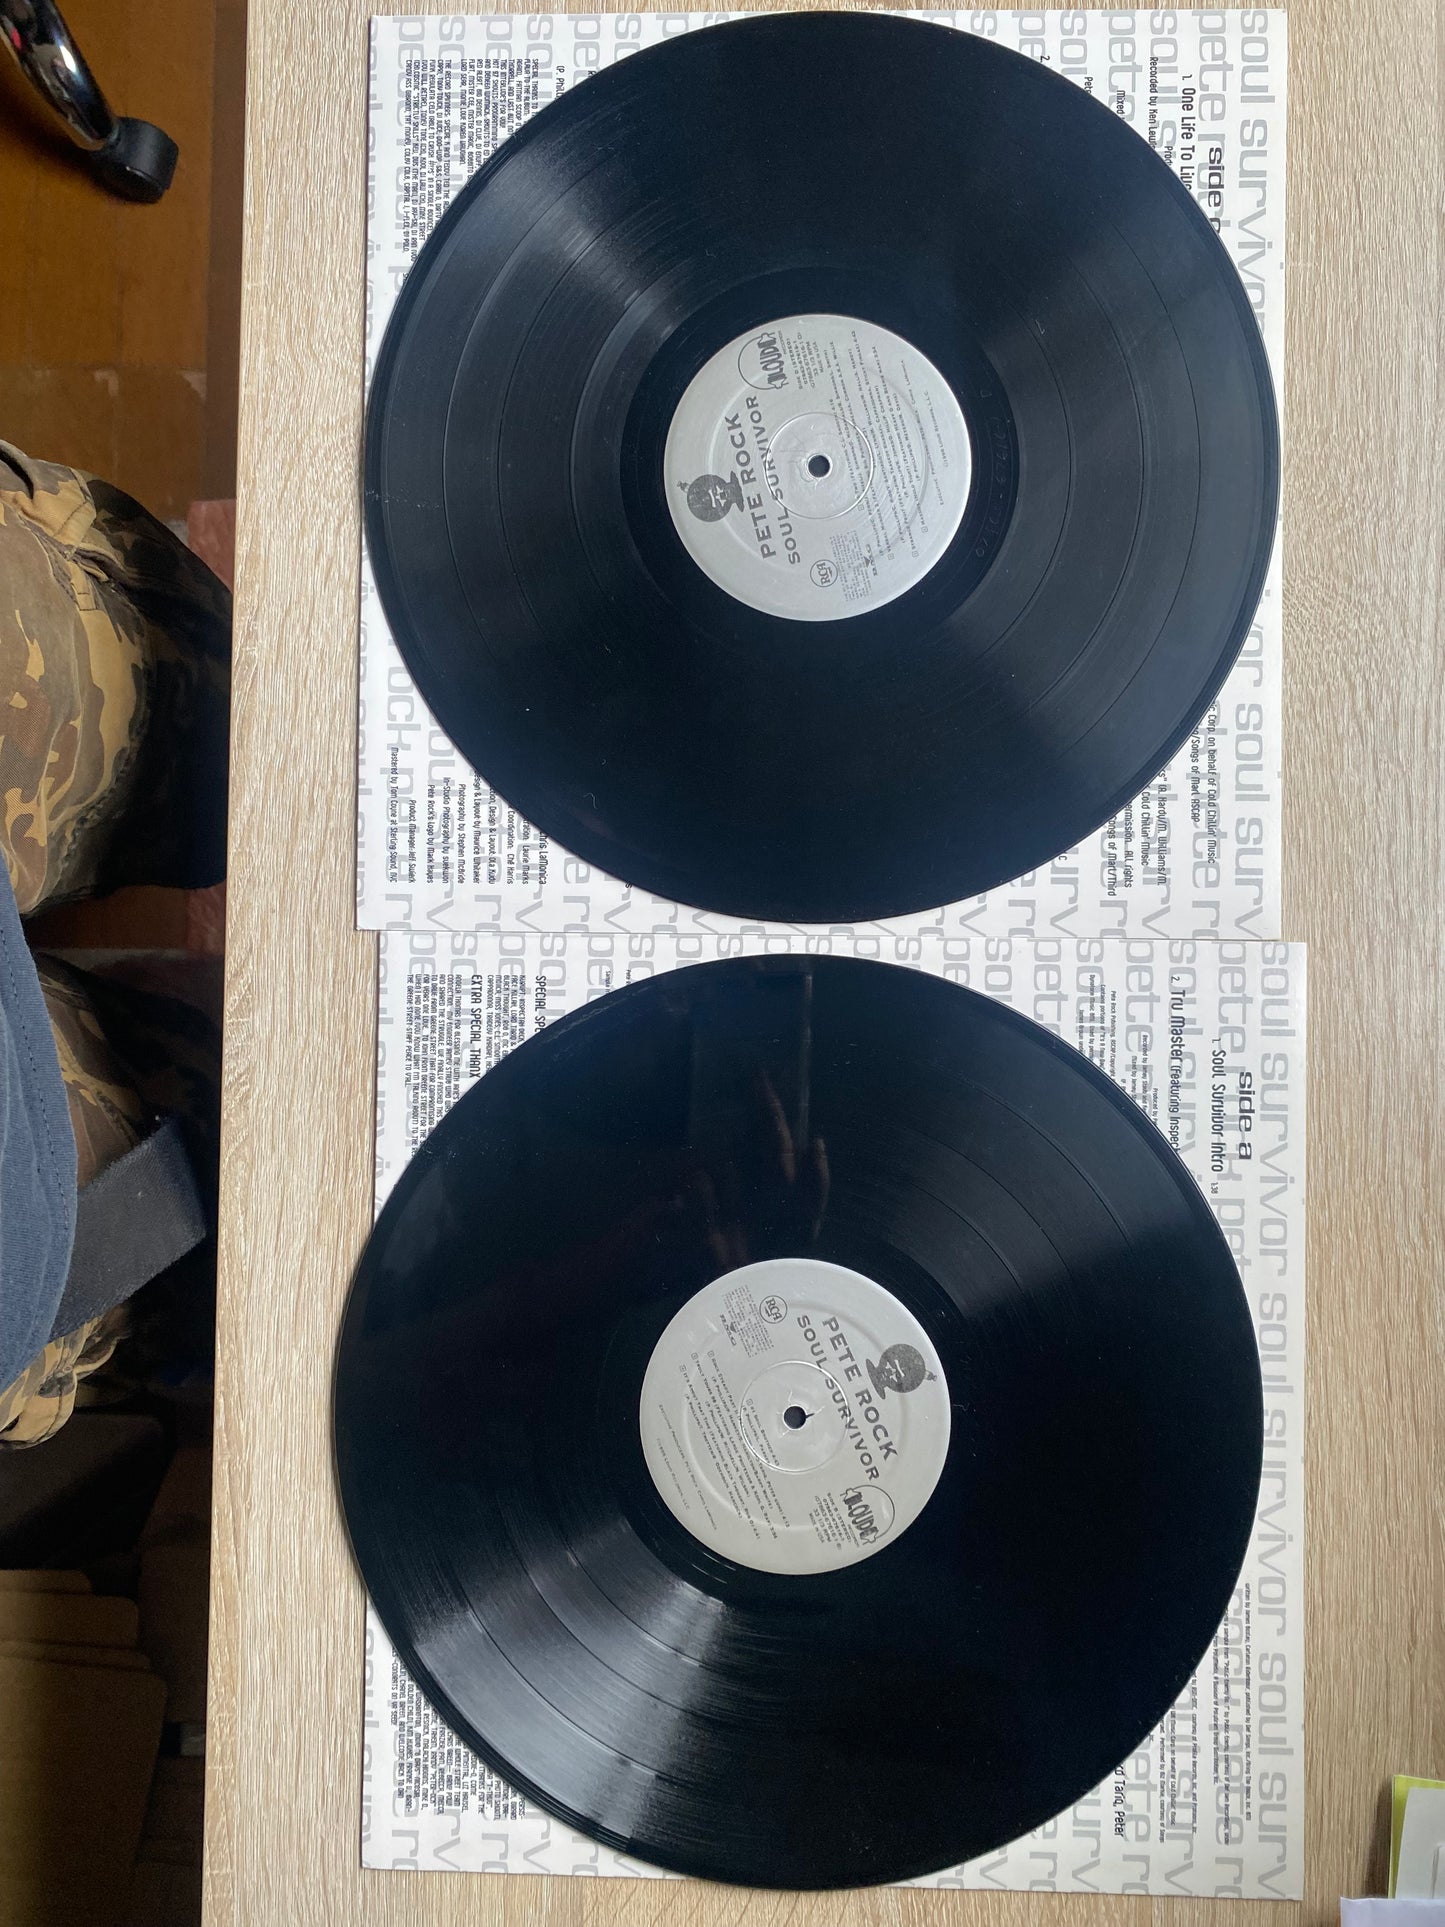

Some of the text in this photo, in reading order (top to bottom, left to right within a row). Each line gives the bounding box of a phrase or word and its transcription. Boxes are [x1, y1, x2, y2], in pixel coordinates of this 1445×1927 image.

[1149, 56, 1159, 93] Recorded
[1192, 10, 1233, 122] pete
[1116, 90, 1126, 114] Mixed
[1148, 96, 1158, 105] by
[1181, 87, 1196, 111] One
[1149, 108, 1158, 124] Ken
[1180, 116, 1195, 140] Life
[1180, 145, 1195, 161] To
[1208, 147, 1225, 208] side
[1238, 10, 1275, 339] soul survivo
[724, 412, 776, 558] PETE ROCK
[744, 394, 801, 565] SOUL SURVIVOR
[815, 561, 831, 584] RCA
[1207, 737, 1217, 747] on
[1235, 703, 1270, 802] soul
[389, 747, 399, 775] Mastered
[1191, 766, 1200, 774] of
[1207, 749, 1217, 776] behalf
[389, 776, 399, 784] by
[389, 785, 399, 799] Tom
[426, 784, 437, 798] Pete
[1207, 778, 1217, 787] of
[408, 799, 418, 822] Product
[457, 783, 467, 822] Photography
[1141, 791, 1150, 811] Cold
[1191, 798, 1200, 823] ASCAP
[1207, 789, 1217, 808] Cold
[441, 806, 452, 845] Photography
[457, 823, 467, 831] by
[472, 820, 482, 829] by
[487, 806, 497, 826] Design
[426, 837, 437, 846] by
[441, 846, 452, 854] by
[457, 832, 467, 858] Stephen
[472, 830, 482, 855] Maurice
[521, 845, 531, 863] Laurie
[1107, 842, 1117, 850] of
[1141, 841, 1150, 867] Music
[1207, 839, 1217, 865] Music
[426, 847, 437, 864] Mark
[538, 850, 549, 885] LaMonica
[1124, 850, 1133, 862] All
[506, 866, 516, 885] Harris
[521, 865, 531, 885] Marks
[1124, 864, 1133, 888] rights
[534, 975, 547, 1012] SPECIAL
[1120, 940, 1161, 1052] pete
[1170, 990, 1185, 1011] Tru
[1211, 942, 1253, 1053] pete
[1260, 942, 1296, 1038] soul
[469, 974, 483, 1078] EXTRA SPECIAL THANX
[1170, 1016, 1186, 1061] Master
[1211, 1049, 1227, 1079] Soul
[1168, 1065, 1181, 1113] (Featuring
[1211, 1083, 1227, 1138] Survivor
[1238, 1071, 1256, 1160] side a
[1211, 1142, 1226, 1172] Intro
[1258, 1052, 1295, 1277] survivor
[765, 1297, 782, 1321] RCA
[796, 1313, 880, 1482] SOUL SURVIVOR
[822, 1315, 897, 1461] PETE ROCK
[1257, 1409, 1295, 1636] survivor
[1257, 1652, 1294, 1757] soul
[1113, 1780, 1126, 1807] Tariq,
[1113, 1811, 1125, 1836] Peter
